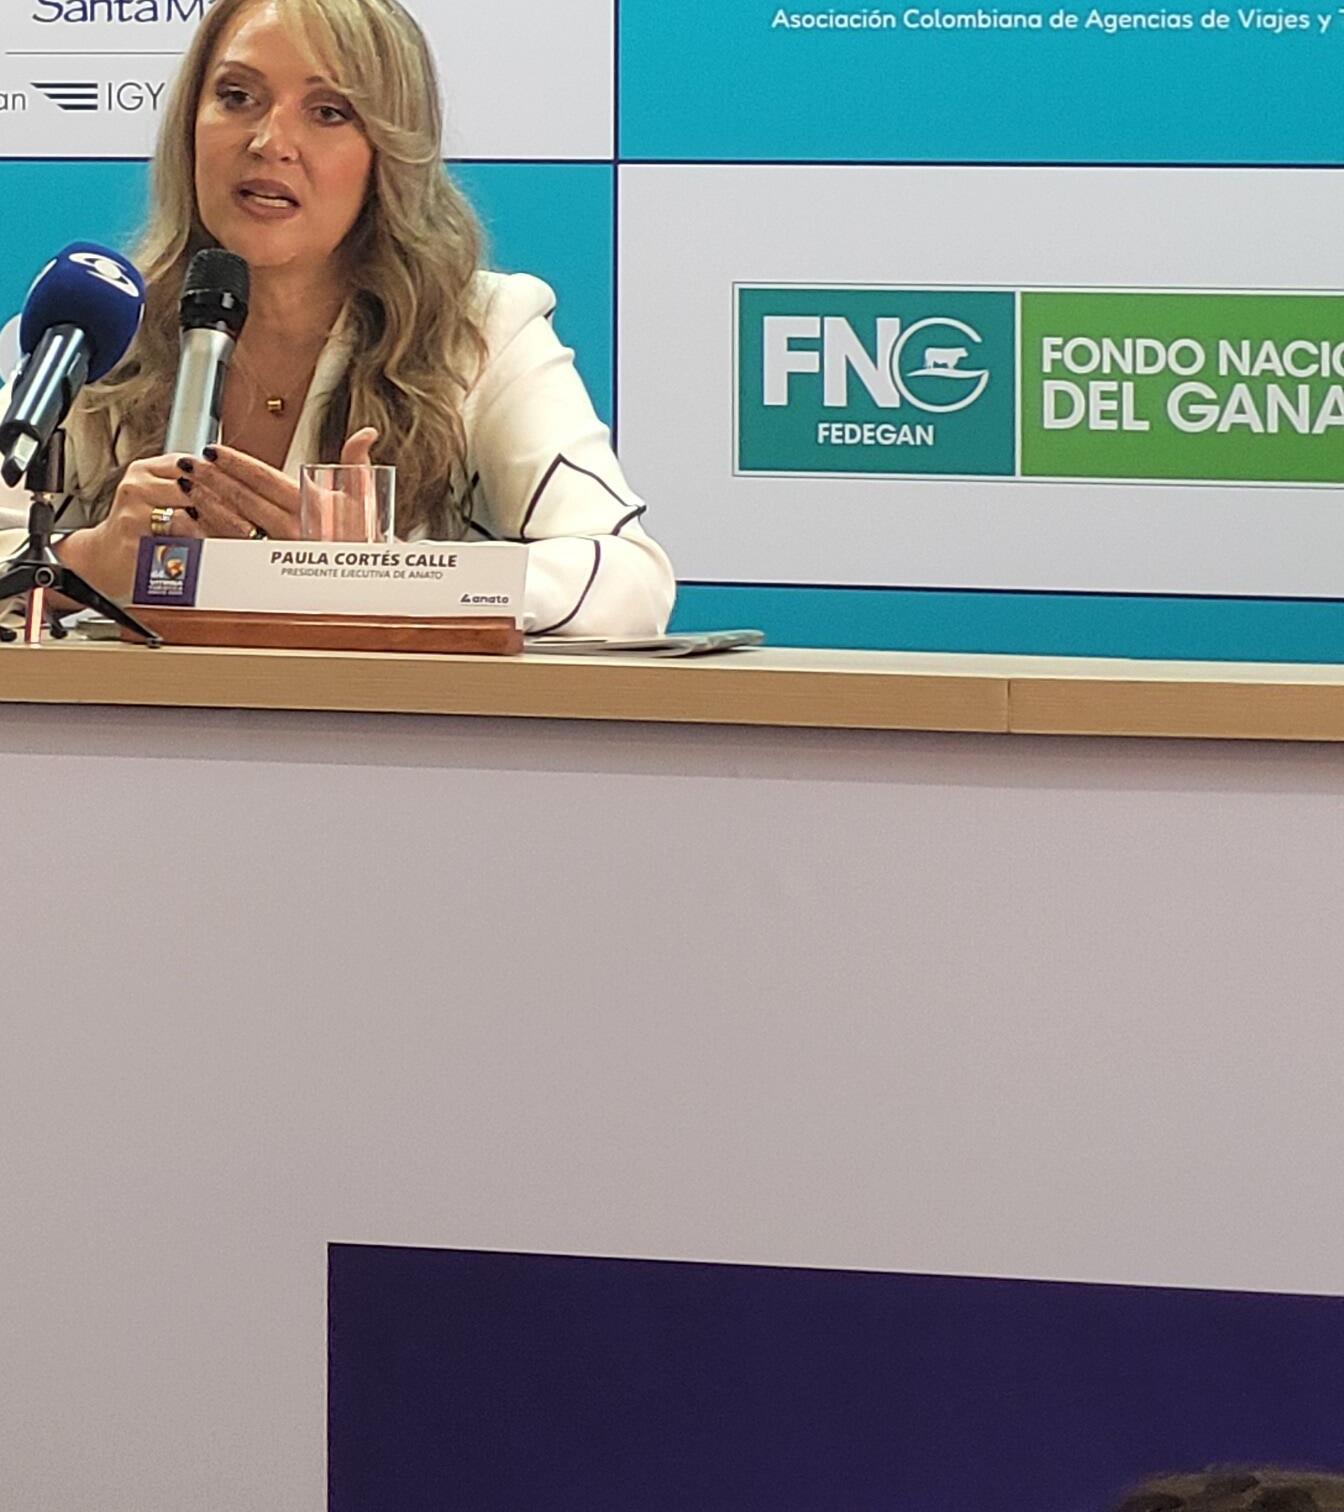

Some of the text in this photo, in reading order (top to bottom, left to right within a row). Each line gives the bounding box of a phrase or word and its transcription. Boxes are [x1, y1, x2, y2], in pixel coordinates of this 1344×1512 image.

[771, 8, 1332, 34] Asociación Colombiana de Agencias de Viajes y
[107, 81, 166, 112] IGY
[1042, 336, 1206, 376] FONDO
[1042, 379, 1151, 431] DEL
[817, 422, 936, 448] FEDEGAN
[270, 550, 457, 568] PAULA CORTÉS CALLE
[281, 567, 444, 580] PRESIDENTE EJECUTIVA DE ANATO
[472, 594, 510, 604] anato
